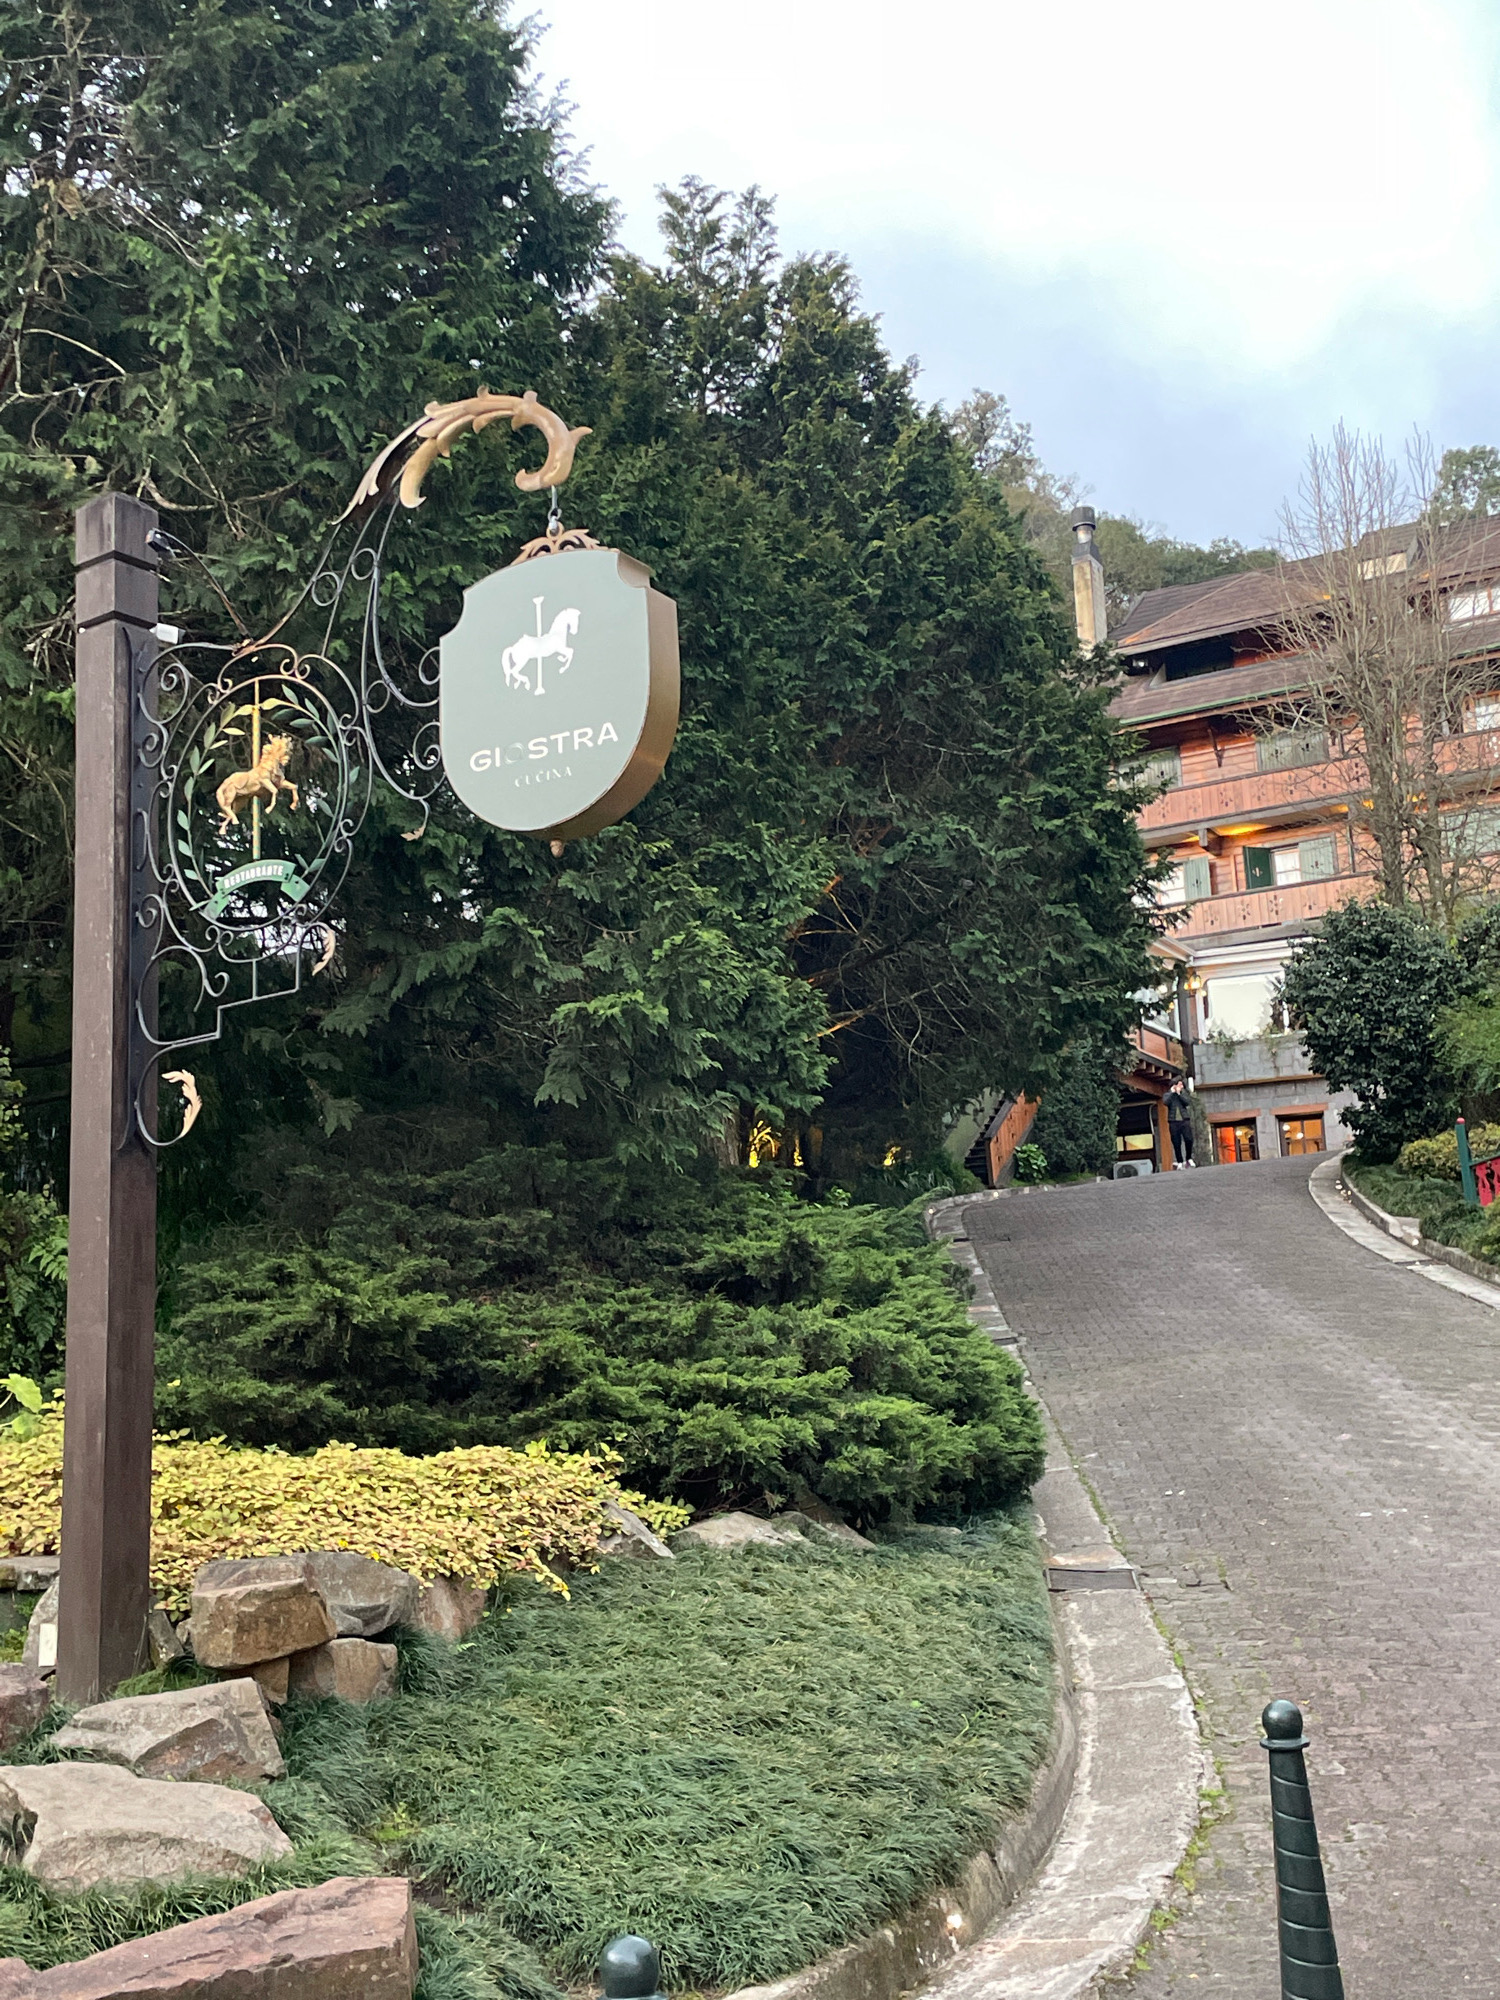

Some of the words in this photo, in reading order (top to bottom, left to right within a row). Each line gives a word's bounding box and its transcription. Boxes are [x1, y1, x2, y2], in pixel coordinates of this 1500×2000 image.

[469, 721, 619, 772] GIOSTRA
[514, 766, 573, 788] CUCINA
[224, 865, 284, 889] RESTAURANTE
